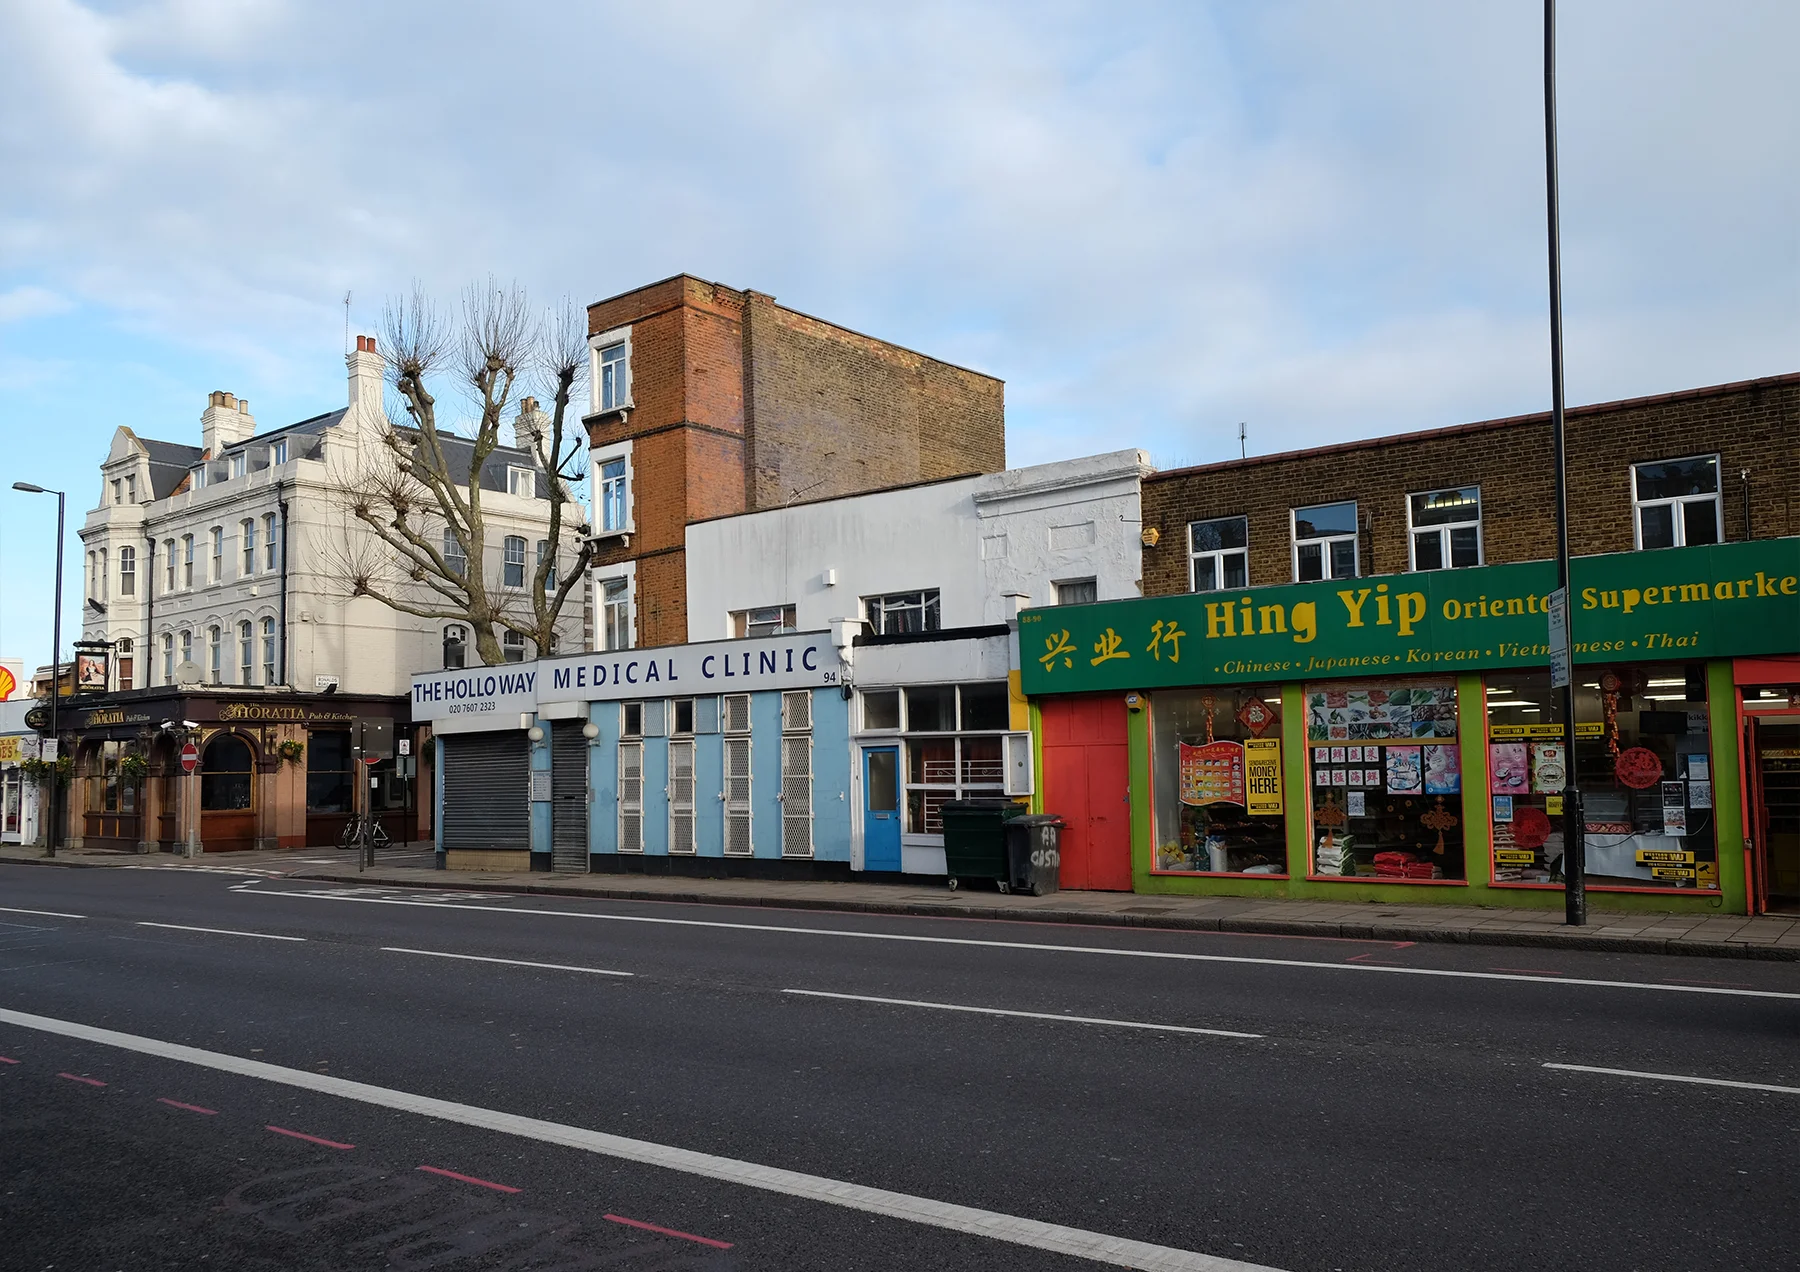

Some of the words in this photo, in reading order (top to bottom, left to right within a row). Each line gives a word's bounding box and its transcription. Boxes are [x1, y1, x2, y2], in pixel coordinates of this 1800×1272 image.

[1206, 596, 1317, 643] Hing
[1337, 583, 1427, 637] Yip
[1442, 594, 1549, 620] Orient
[1581, 571, 1798, 614] Supermarke
[1022, 615, 1042, 624] 88-90
[1223, 659, 1291, 675] Chinese
[1305, 654, 1390, 672] Japanese
[1406, 648, 1480, 663] Korean
[1498, 639, 1625, 658] Vietnmese
[1644, 631, 1699, 649] Thai
[413, 681, 442, 703] THE
[554, 658, 678, 690] MEDICAL
[701, 646, 818, 679] CLINIC
[823, 671, 837, 684] 94
[236, 706, 307, 720] HORATIA
[448, 704, 462, 714] 020
[462, 703, 478, 713] 7607
[480, 701, 496, 711] 2323
[93, 712, 124, 725] HORATIA
[1249, 766, 1277, 778] MONEY
[1250, 777, 1279, 794] HERE
